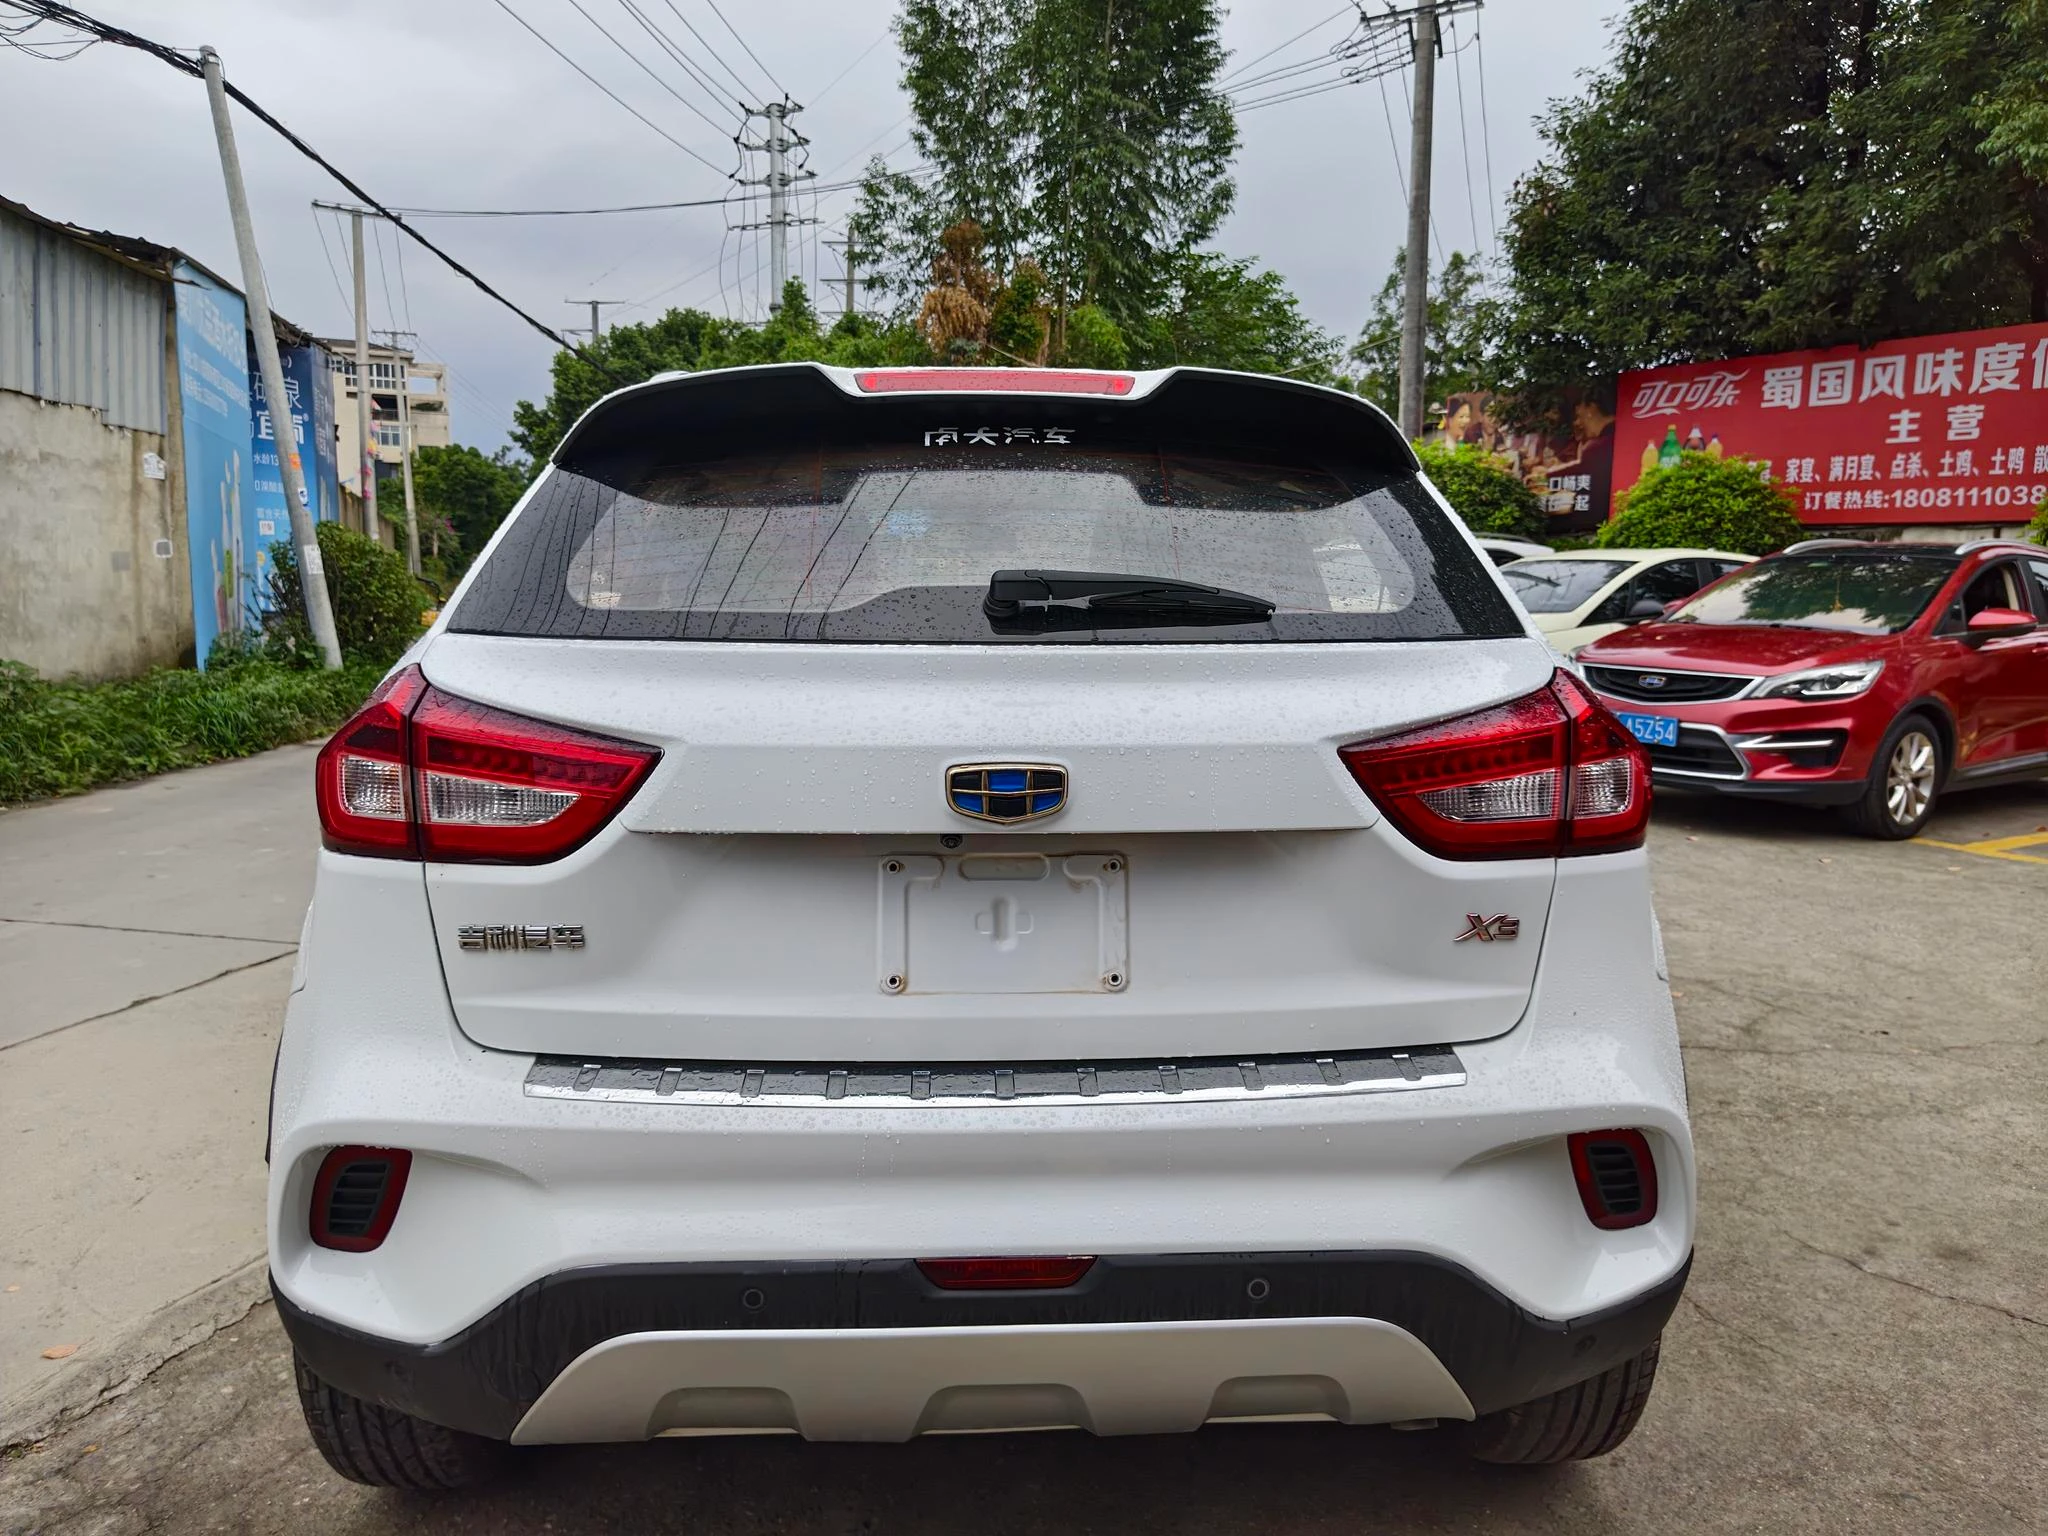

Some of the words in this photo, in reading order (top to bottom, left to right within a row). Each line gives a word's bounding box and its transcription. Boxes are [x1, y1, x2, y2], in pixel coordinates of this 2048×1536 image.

[1632, 370, 1749, 418] 可口可乐
[458, 924, 585, 950] 吉利汽车
[1453, 913, 1520, 941] X3
